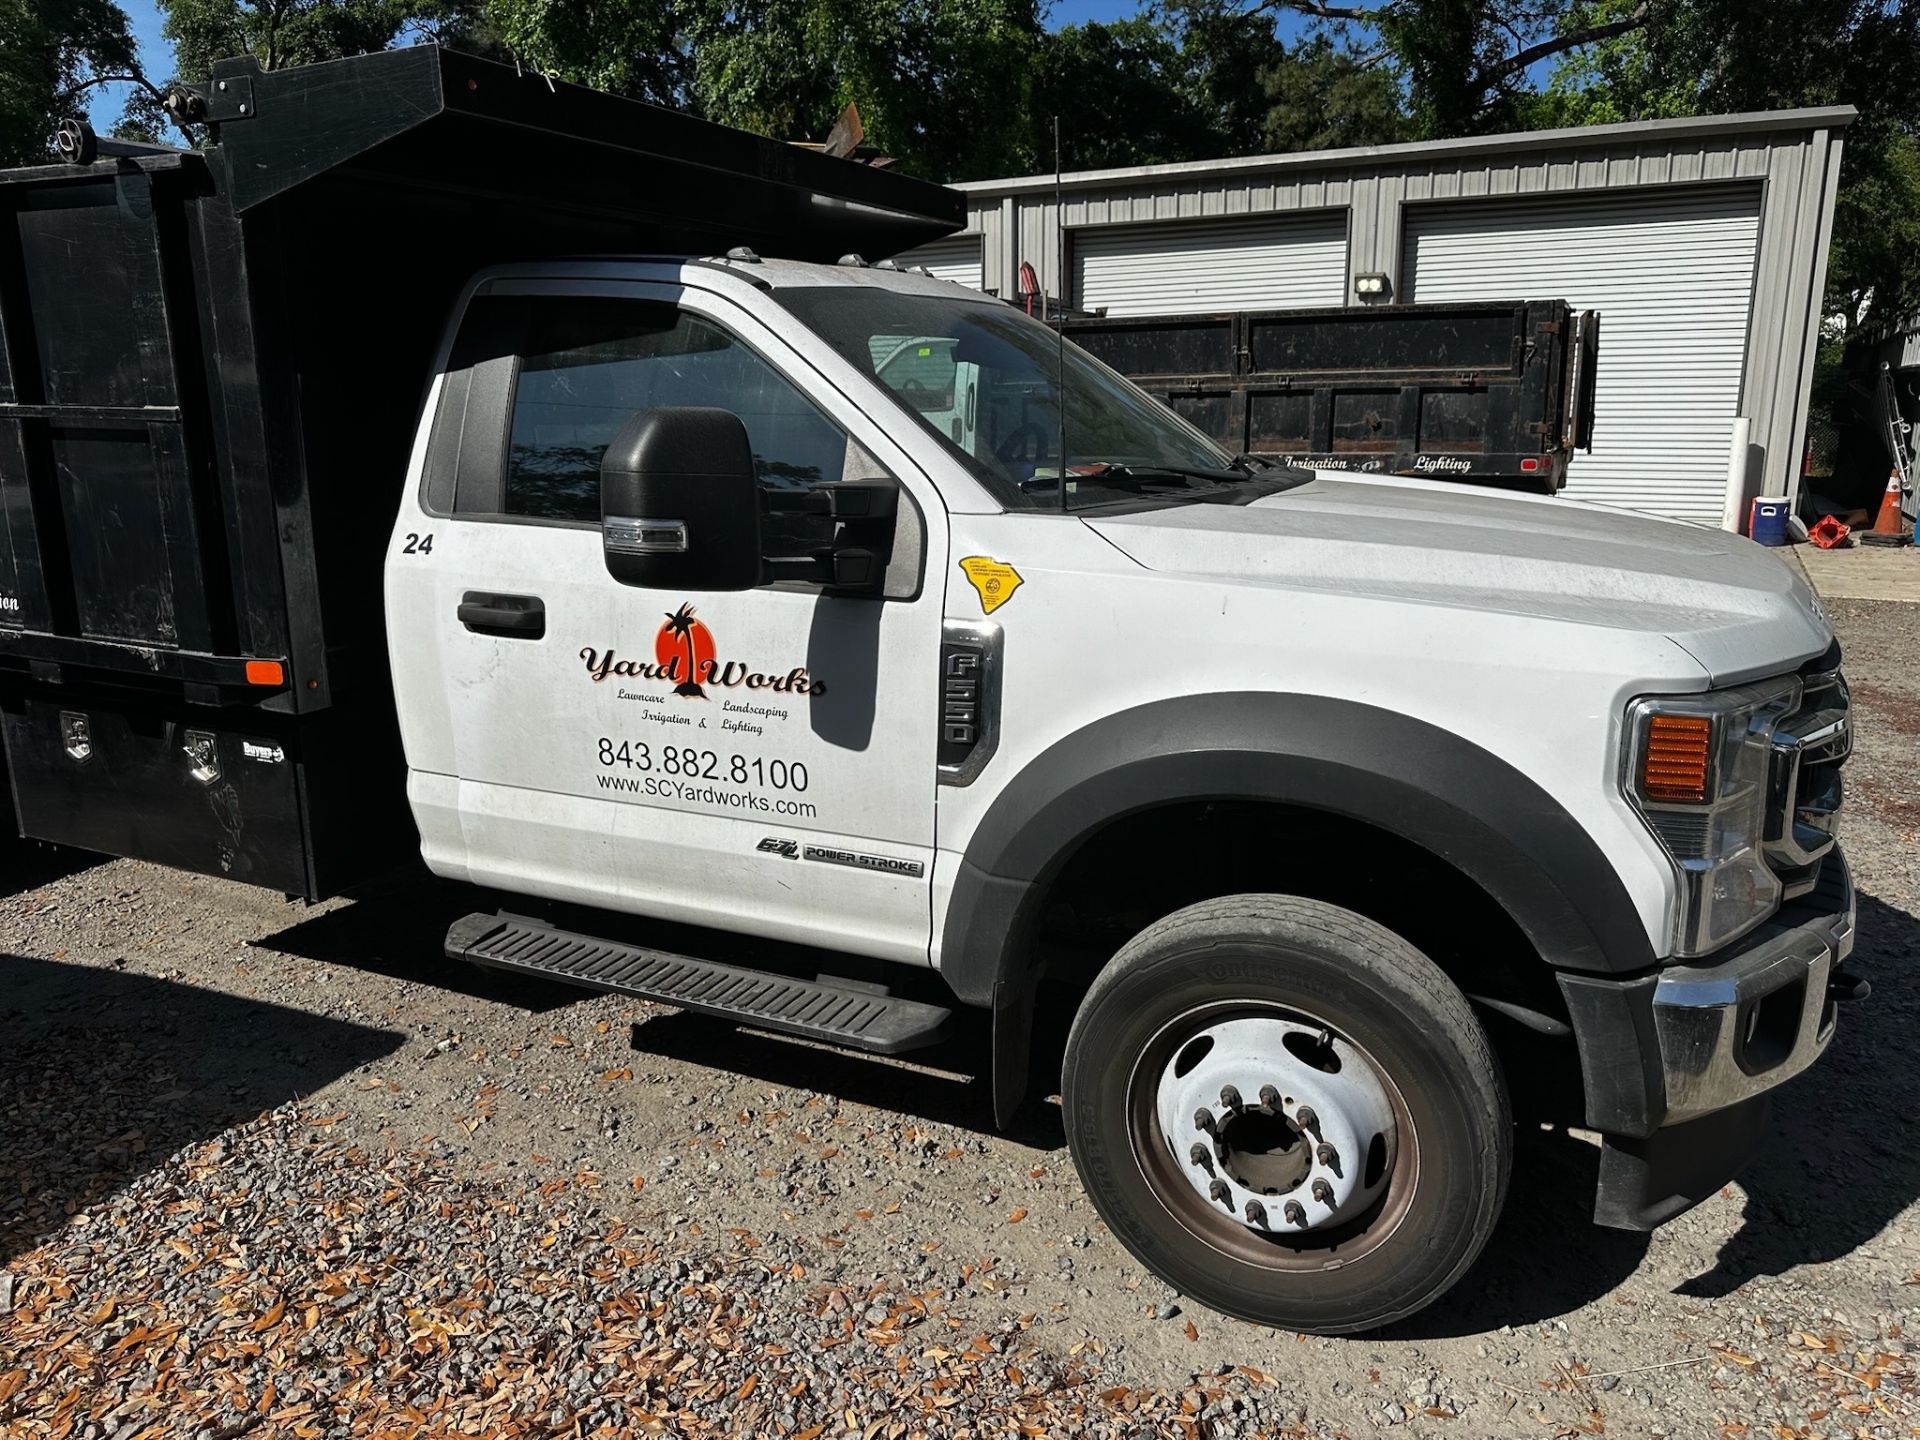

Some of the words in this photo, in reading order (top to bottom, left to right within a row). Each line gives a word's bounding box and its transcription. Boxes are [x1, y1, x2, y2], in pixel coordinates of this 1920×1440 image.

[1285, 455, 1347, 469] Irrigation
[1413, 456, 1472, 473] Lighting
[402, 532, 433, 555] 24
[579, 647, 681, 682] Yard
[700, 659, 827, 697] Works
[617, 688, 665, 704] Lawncare
[722, 700, 788, 720] Landscaping
[641, 709, 691, 726] Irrigation
[698, 718, 707, 729] &
[721, 719, 763, 735] Lighting
[598, 737, 808, 792] 843.882.8100
[597, 774, 817, 818] www.SCYardworks.com
[806, 847, 856, 863] POWER
[859, 855, 919, 873] STROKE
